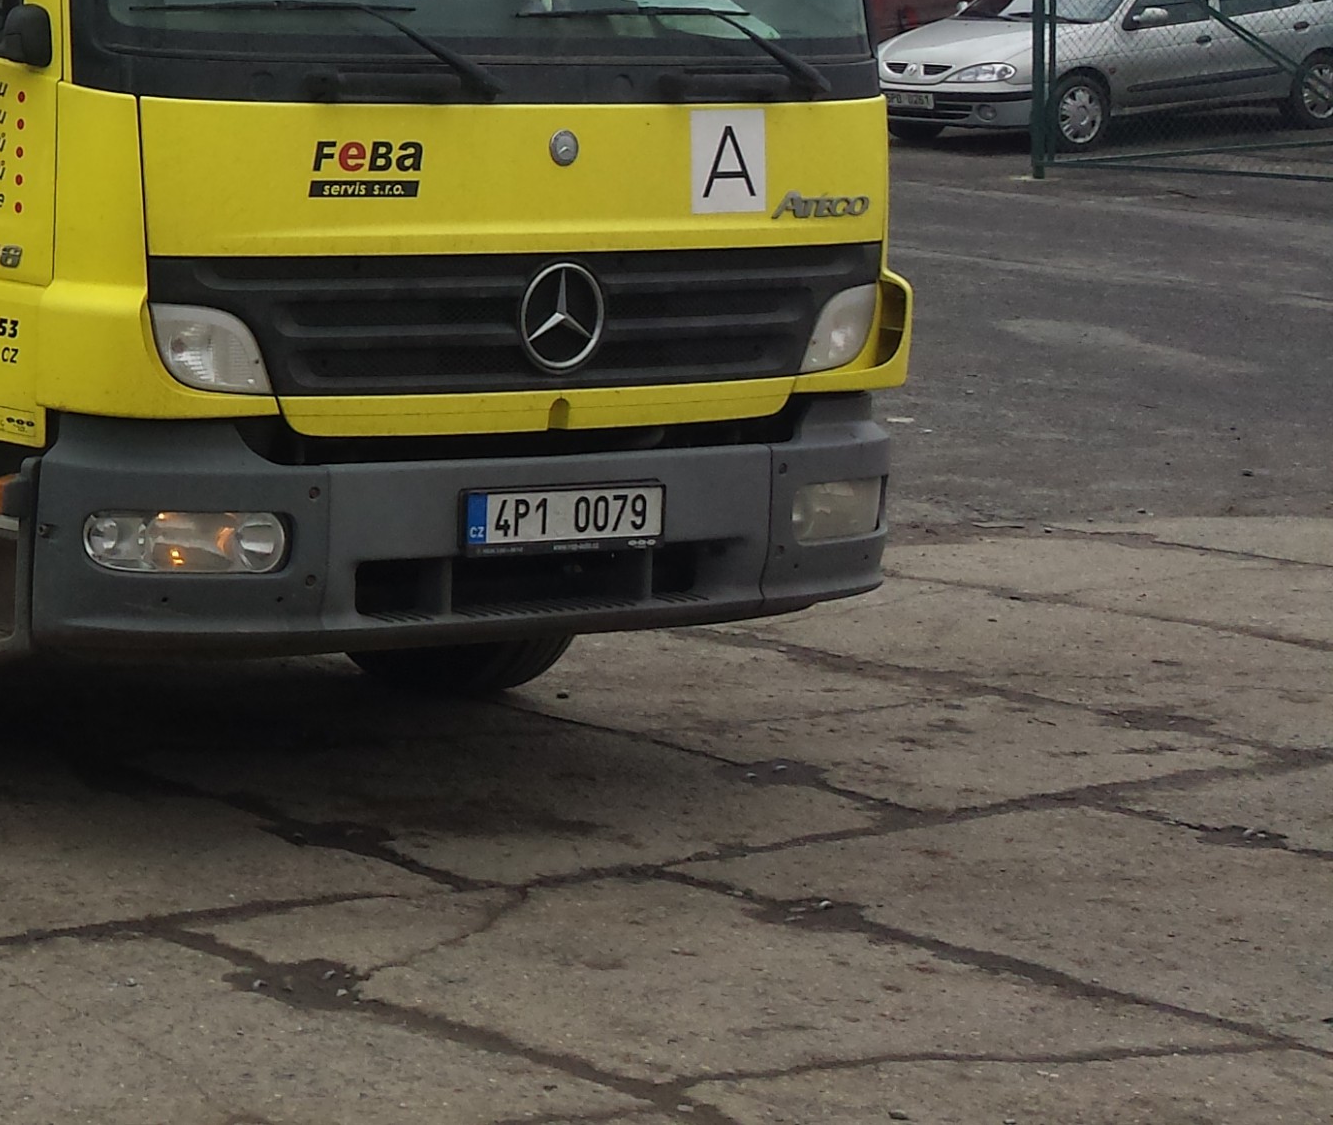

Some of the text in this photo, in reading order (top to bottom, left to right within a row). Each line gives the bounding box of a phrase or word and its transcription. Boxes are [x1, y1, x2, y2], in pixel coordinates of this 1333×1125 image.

[312, 141, 423, 172] FeBa
[702, 125, 756, 198] A
[322, 182, 405, 195] servis s.r.o.
[469, 494, 648, 538] CZ 4P1 0079
